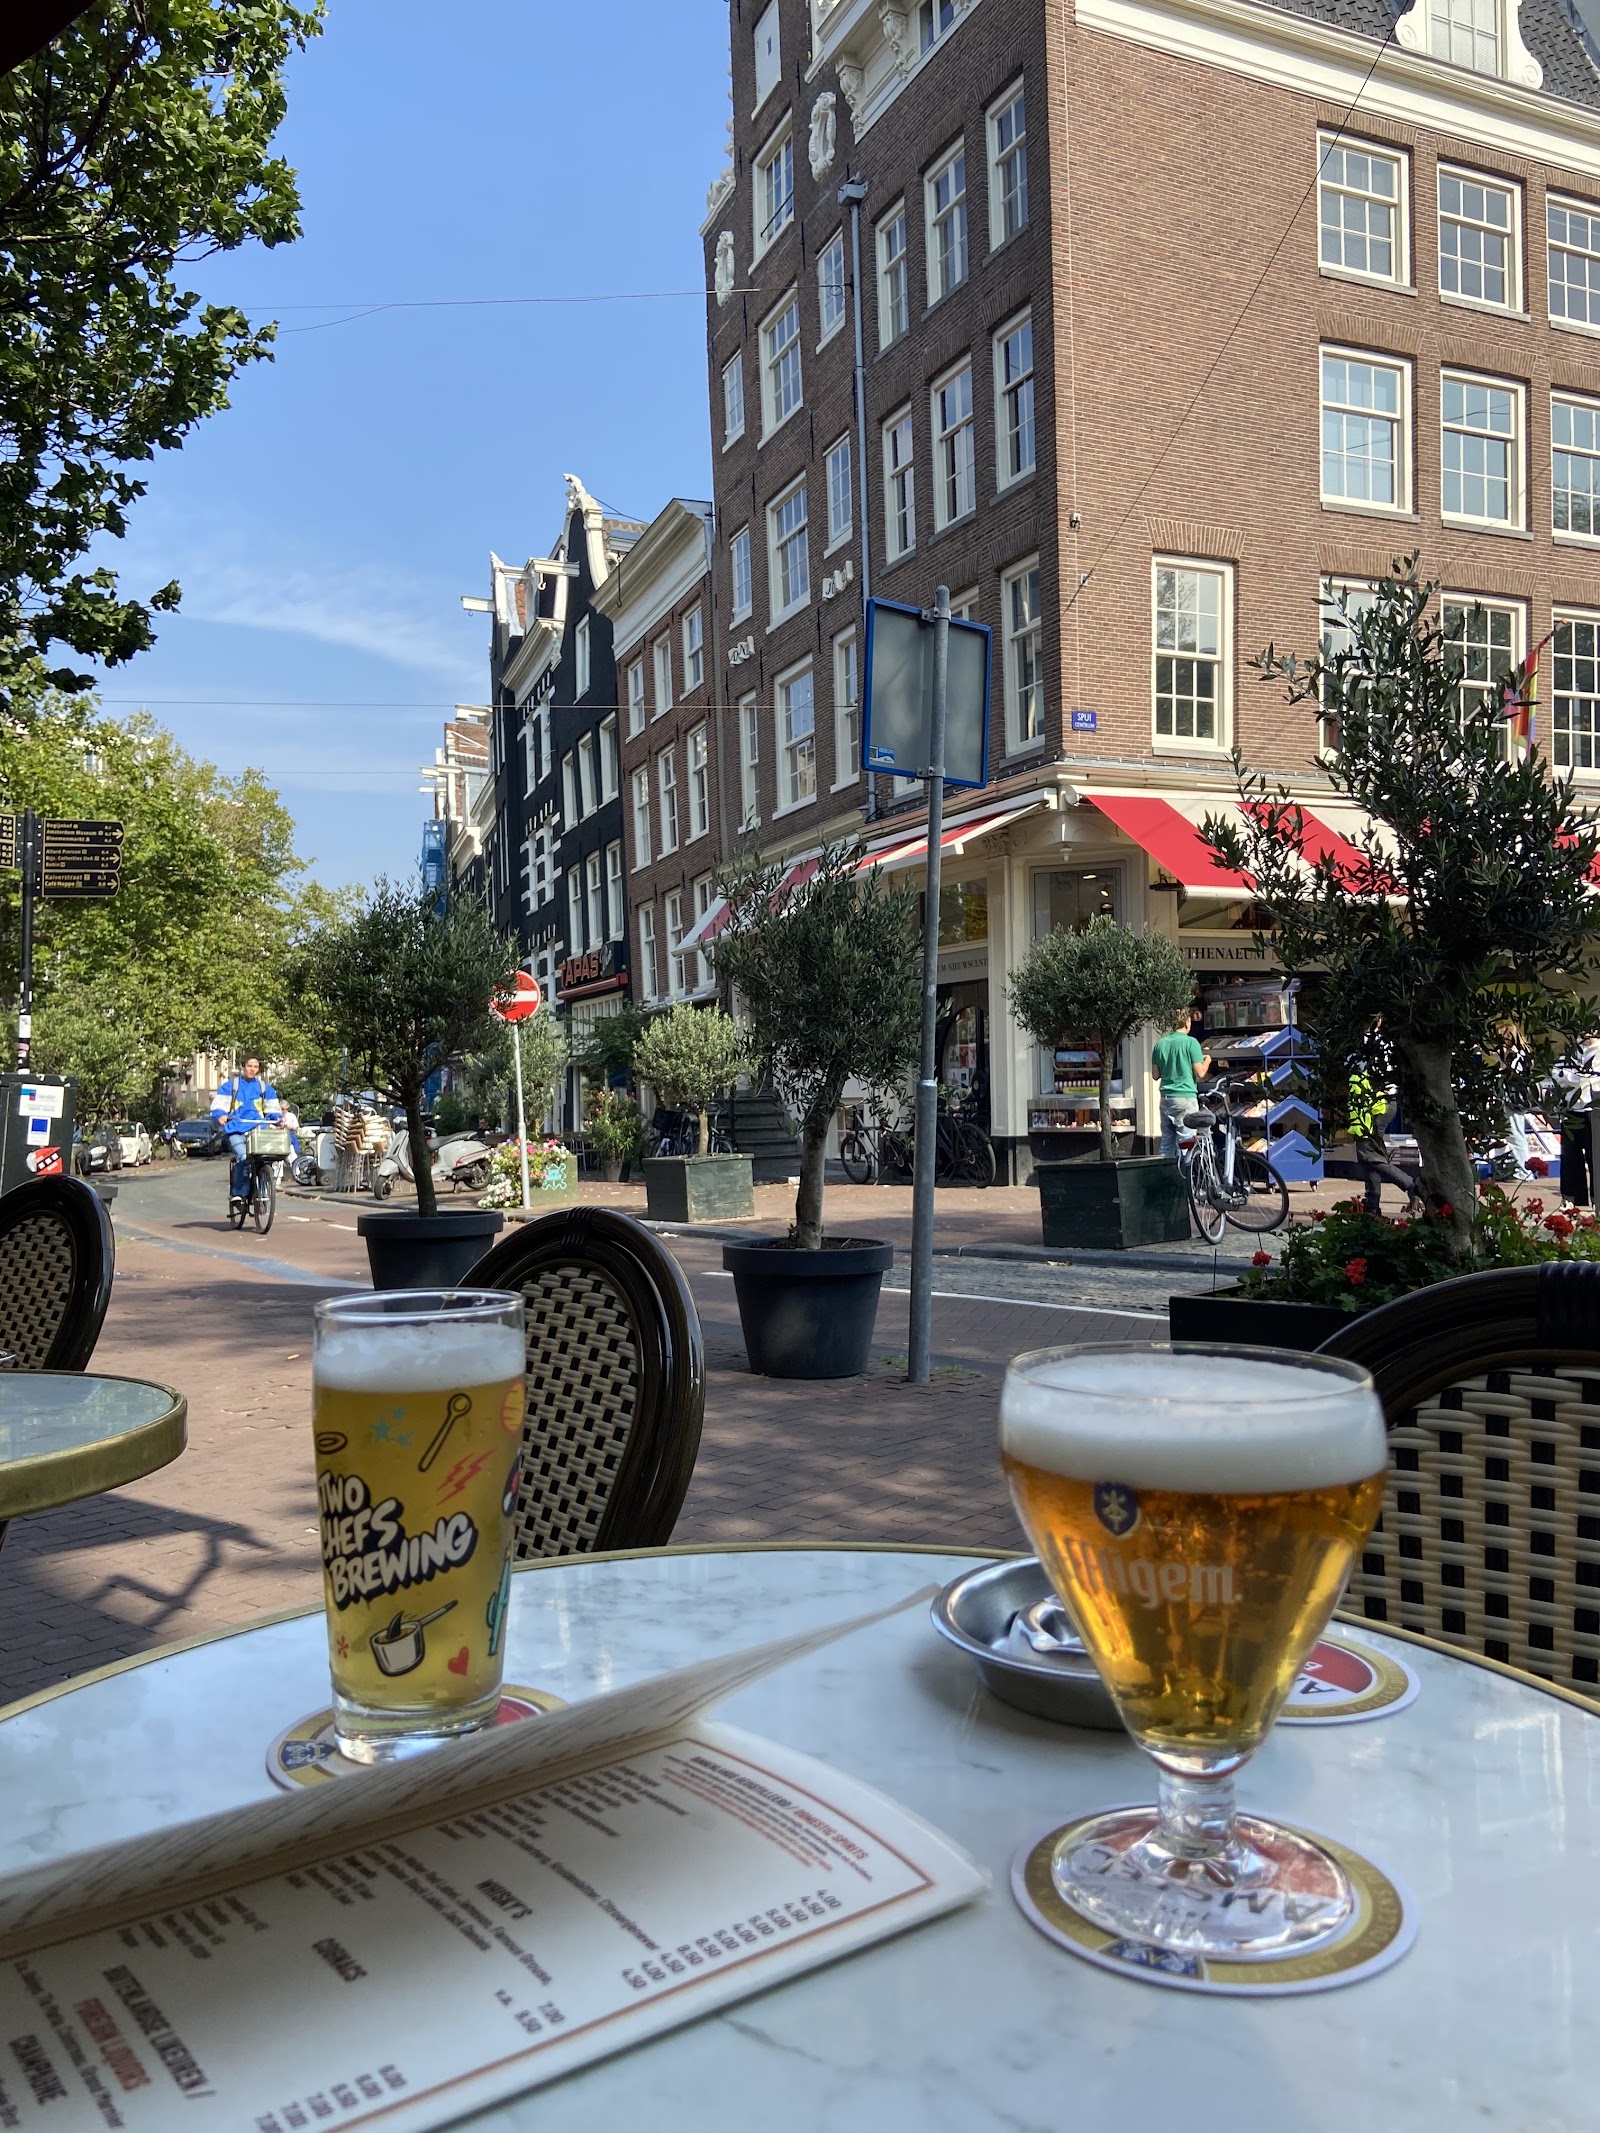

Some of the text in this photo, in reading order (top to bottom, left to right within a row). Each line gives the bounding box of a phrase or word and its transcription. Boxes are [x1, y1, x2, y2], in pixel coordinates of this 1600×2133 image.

[1074, 721, 1095, 729] CENTRUM
[1077, 712, 1092, 722] SPUI
[558, 950, 600, 989] TAPAS
[318, 1471, 370, 1516] TWO
[329, 1511, 478, 1607] BREWING
[794, 1808, 836, 1836] DOMESTIC
[831, 1833, 869, 1860] SPIRITS
[800, 1895, 826, 1916] 4.50
[816, 1888, 842, 1909] 4.00
[765, 1908, 792, 1929] 5.00
[783, 1902, 809, 1923] 4.50
[598, 1898, 661, 1951] Citroenjenever
[659, 1951, 686, 1974] 4.50
[732, 1922, 758, 1943] 4.00
[748, 1915, 775, 1936] 5.00
[695, 1936, 722, 1958] 6.50
[713, 1929, 740, 1950] 5.00
[677, 1943, 704, 1966] 8.50
[621, 1968, 648, 1990] 4.50
[640, 1959, 667, 1982] 4.00
